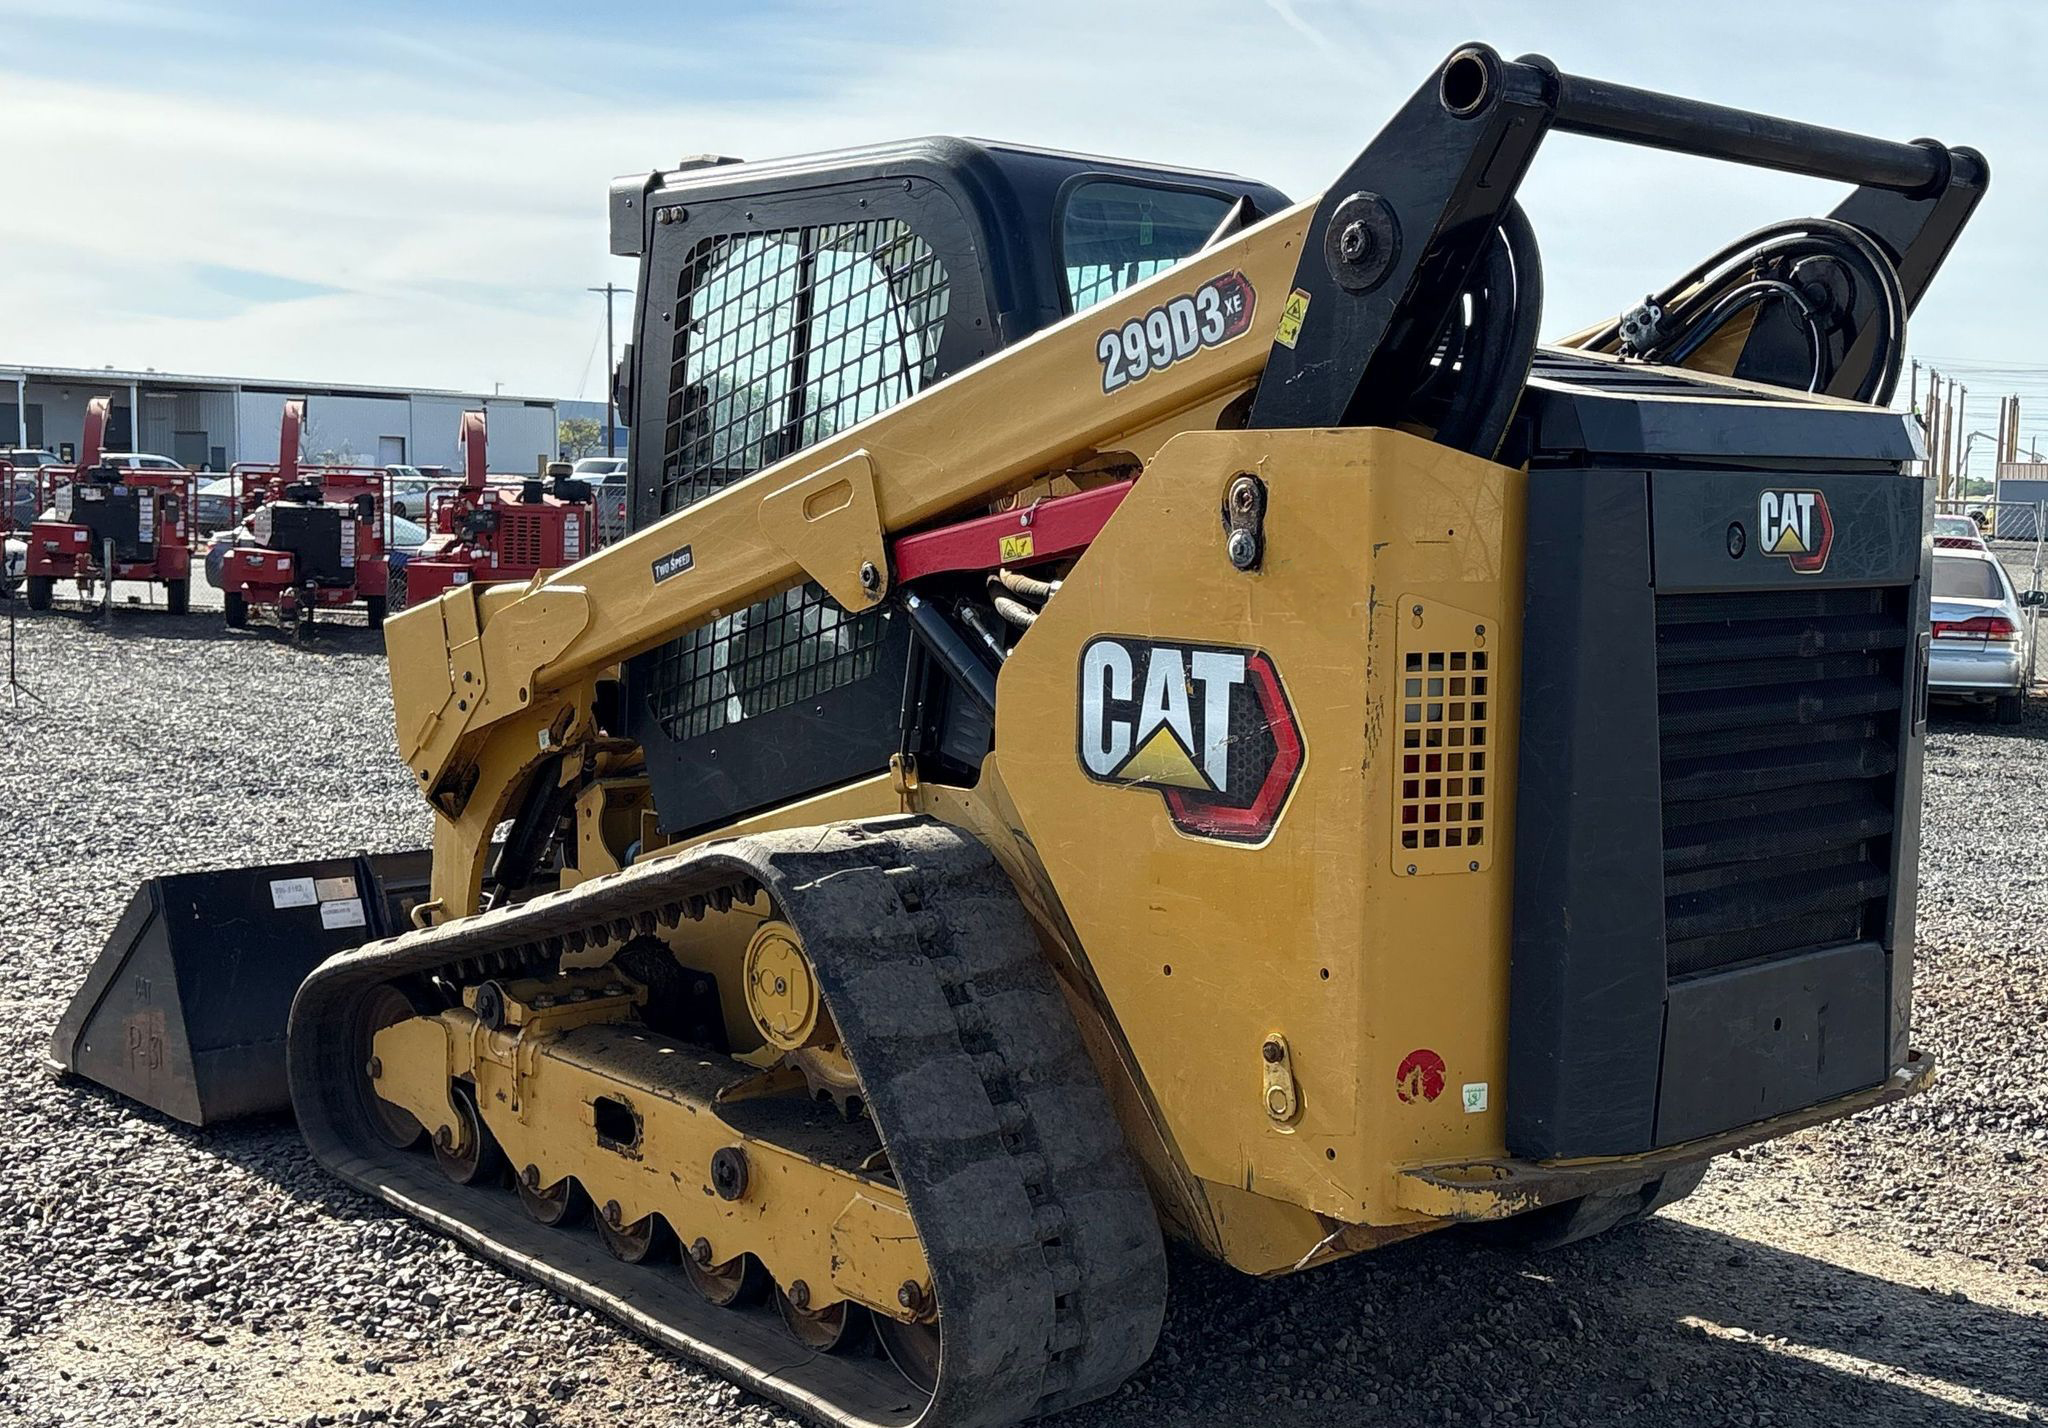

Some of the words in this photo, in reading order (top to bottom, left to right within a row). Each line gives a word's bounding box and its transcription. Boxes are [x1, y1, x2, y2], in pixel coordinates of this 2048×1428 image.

[1098, 285, 1226, 393] 299D3
[1223, 294, 1243, 317] XE
[1759, 491, 1816, 553] CAT
[655, 563, 669, 578] TWO
[670, 553, 690, 570] SPEED
[1083, 640, 1246, 793] CAT
